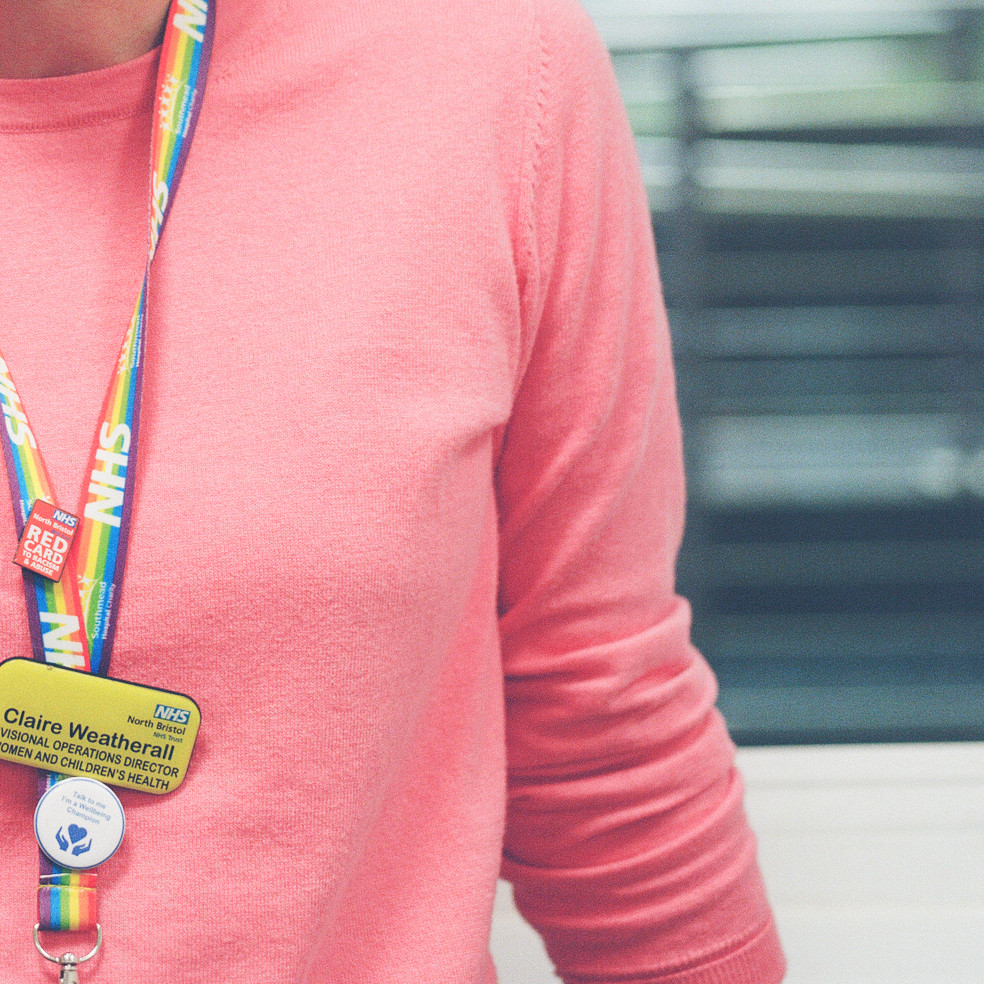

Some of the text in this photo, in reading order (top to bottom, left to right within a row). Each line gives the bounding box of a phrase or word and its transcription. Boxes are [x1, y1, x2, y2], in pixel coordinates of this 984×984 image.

[84, 422, 131, 527] NHS
[33, 513, 52, 526] North
[53, 522, 74, 536] Bristol
[53, 509, 77, 527] NHS
[27, 524, 68, 554] RED
[22, 549, 60, 571] TO RACISM
[24, 540, 63, 565] CARD
[30, 561, 54, 576] ABUSE
[91, 581, 106, 639] Southmead
[127, 715, 186, 735] North Bristol
[154, 705, 190, 724] NHS
[3, 707, 175, 761] Claire Weatherall
[153, 731, 183, 743] NHS Trust
[34, 750, 59, 765] AND
[60, 756, 126, 781] CHILDREN'S
[127, 772, 170, 791] HEALTH
[52, 740, 122, 765] OPERATIONS
[123, 756, 179, 778] DIRECTOR
[61, 795, 72, 804] I'm
[79, 802, 111, 821] Wellbeing
[73, 790, 106, 809] Talk to me
[66, 806, 100, 825] Champion
